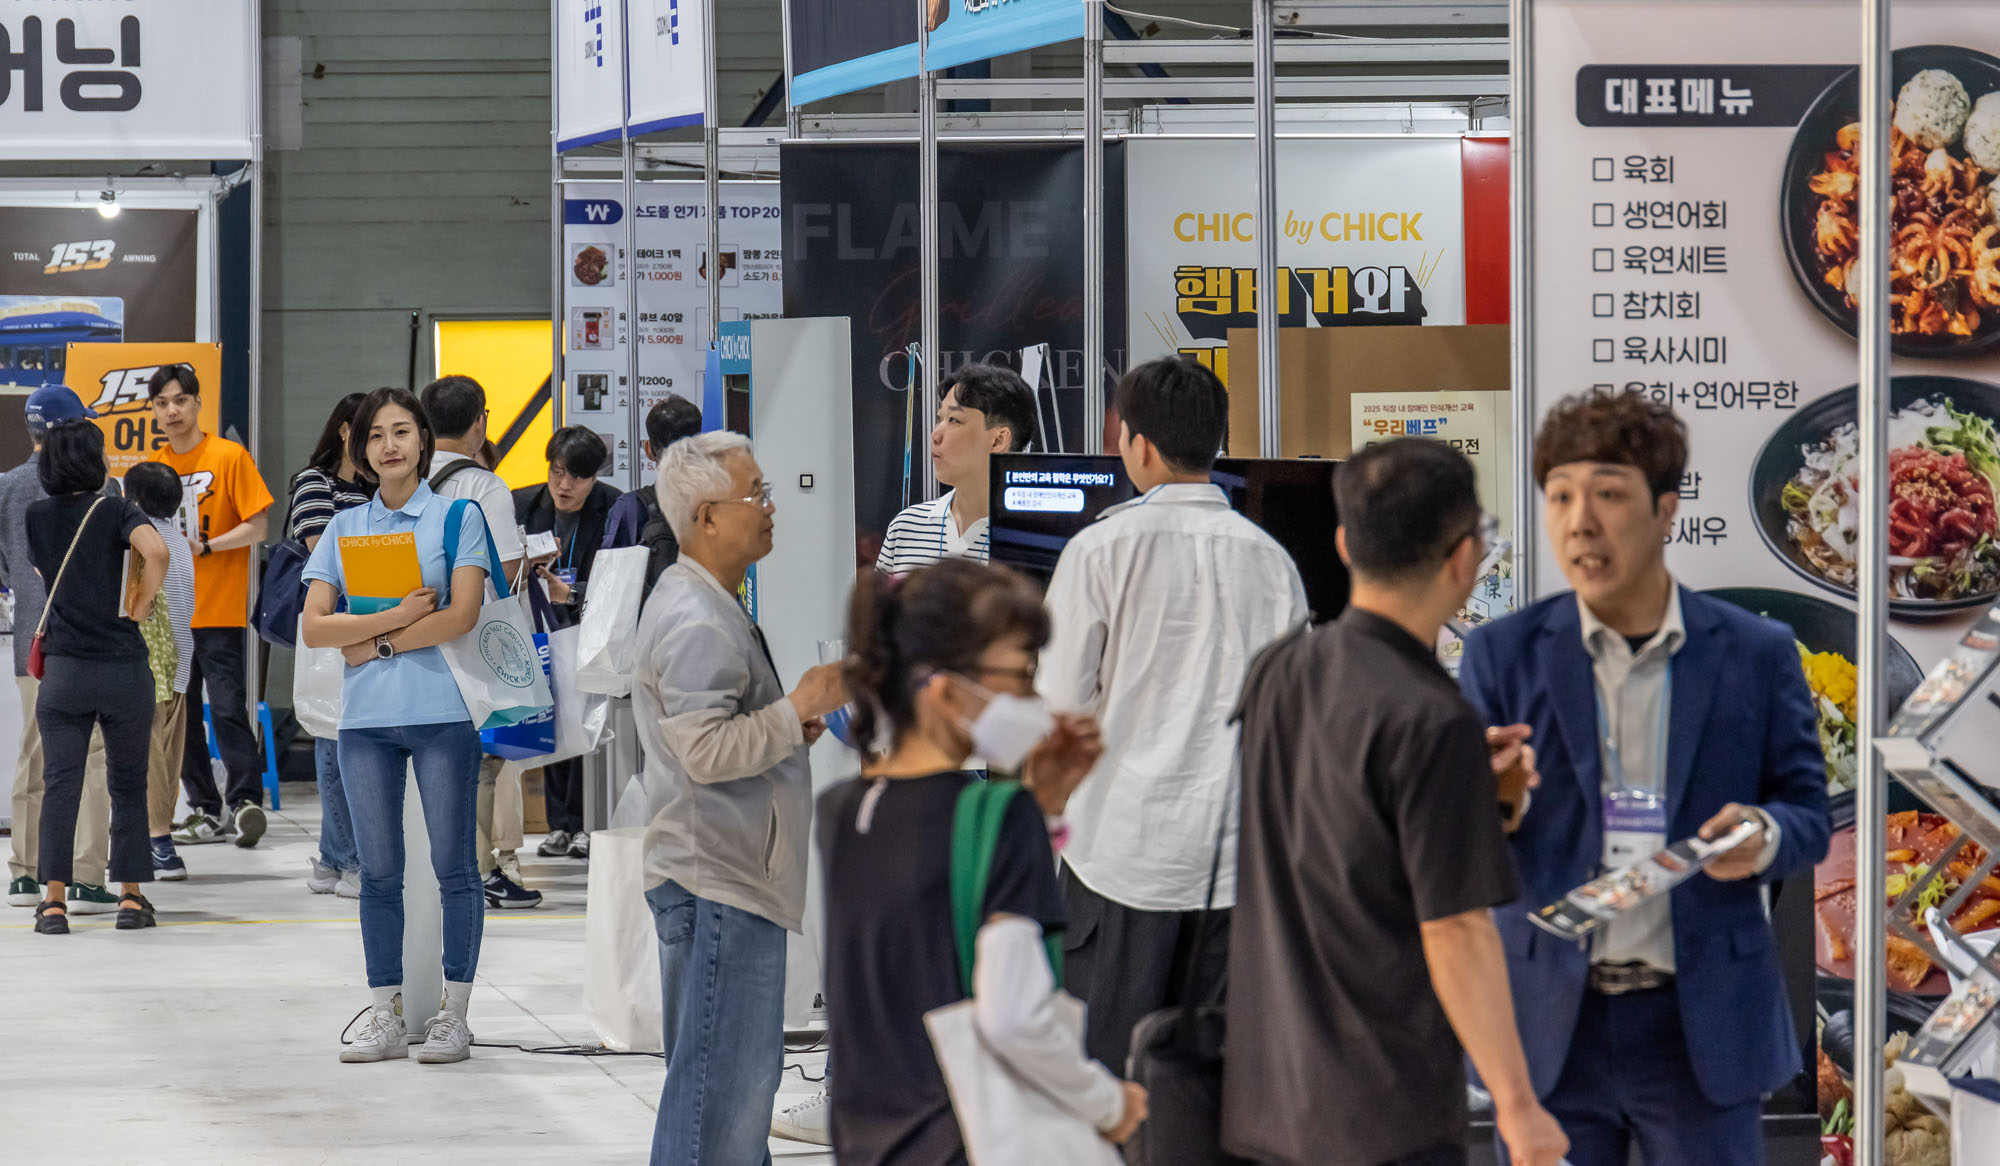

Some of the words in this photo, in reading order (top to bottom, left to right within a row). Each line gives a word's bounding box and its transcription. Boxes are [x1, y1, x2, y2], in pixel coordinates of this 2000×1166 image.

[1605, 78, 1754, 116] 대표메뉴
[1623, 156, 1675, 184] 육회
[673, 205, 698, 219] 인기
[1623, 201, 1728, 230] 생연어회
[793, 202, 1049, 261] FLAME
[1173, 212, 1258, 243] CHIC
[1284, 210, 1313, 246] by
[1319, 212, 1424, 242] CHICK
[13, 252, 40, 262] TOTAL
[122, 254, 157, 263] AWNING
[43, 239, 116, 275] 153
[1623, 246, 1728, 275] 육연세트
[618, 271, 645, 281] 소가
[1623, 291, 1701, 320] 참치회
[618, 335, 645, 344] 소가
[1623, 336, 1727, 365] 육사시미
[90, 362, 196, 416] 15
[341, 538, 369, 547] CHICK
[381, 534, 412, 546] CHICK
